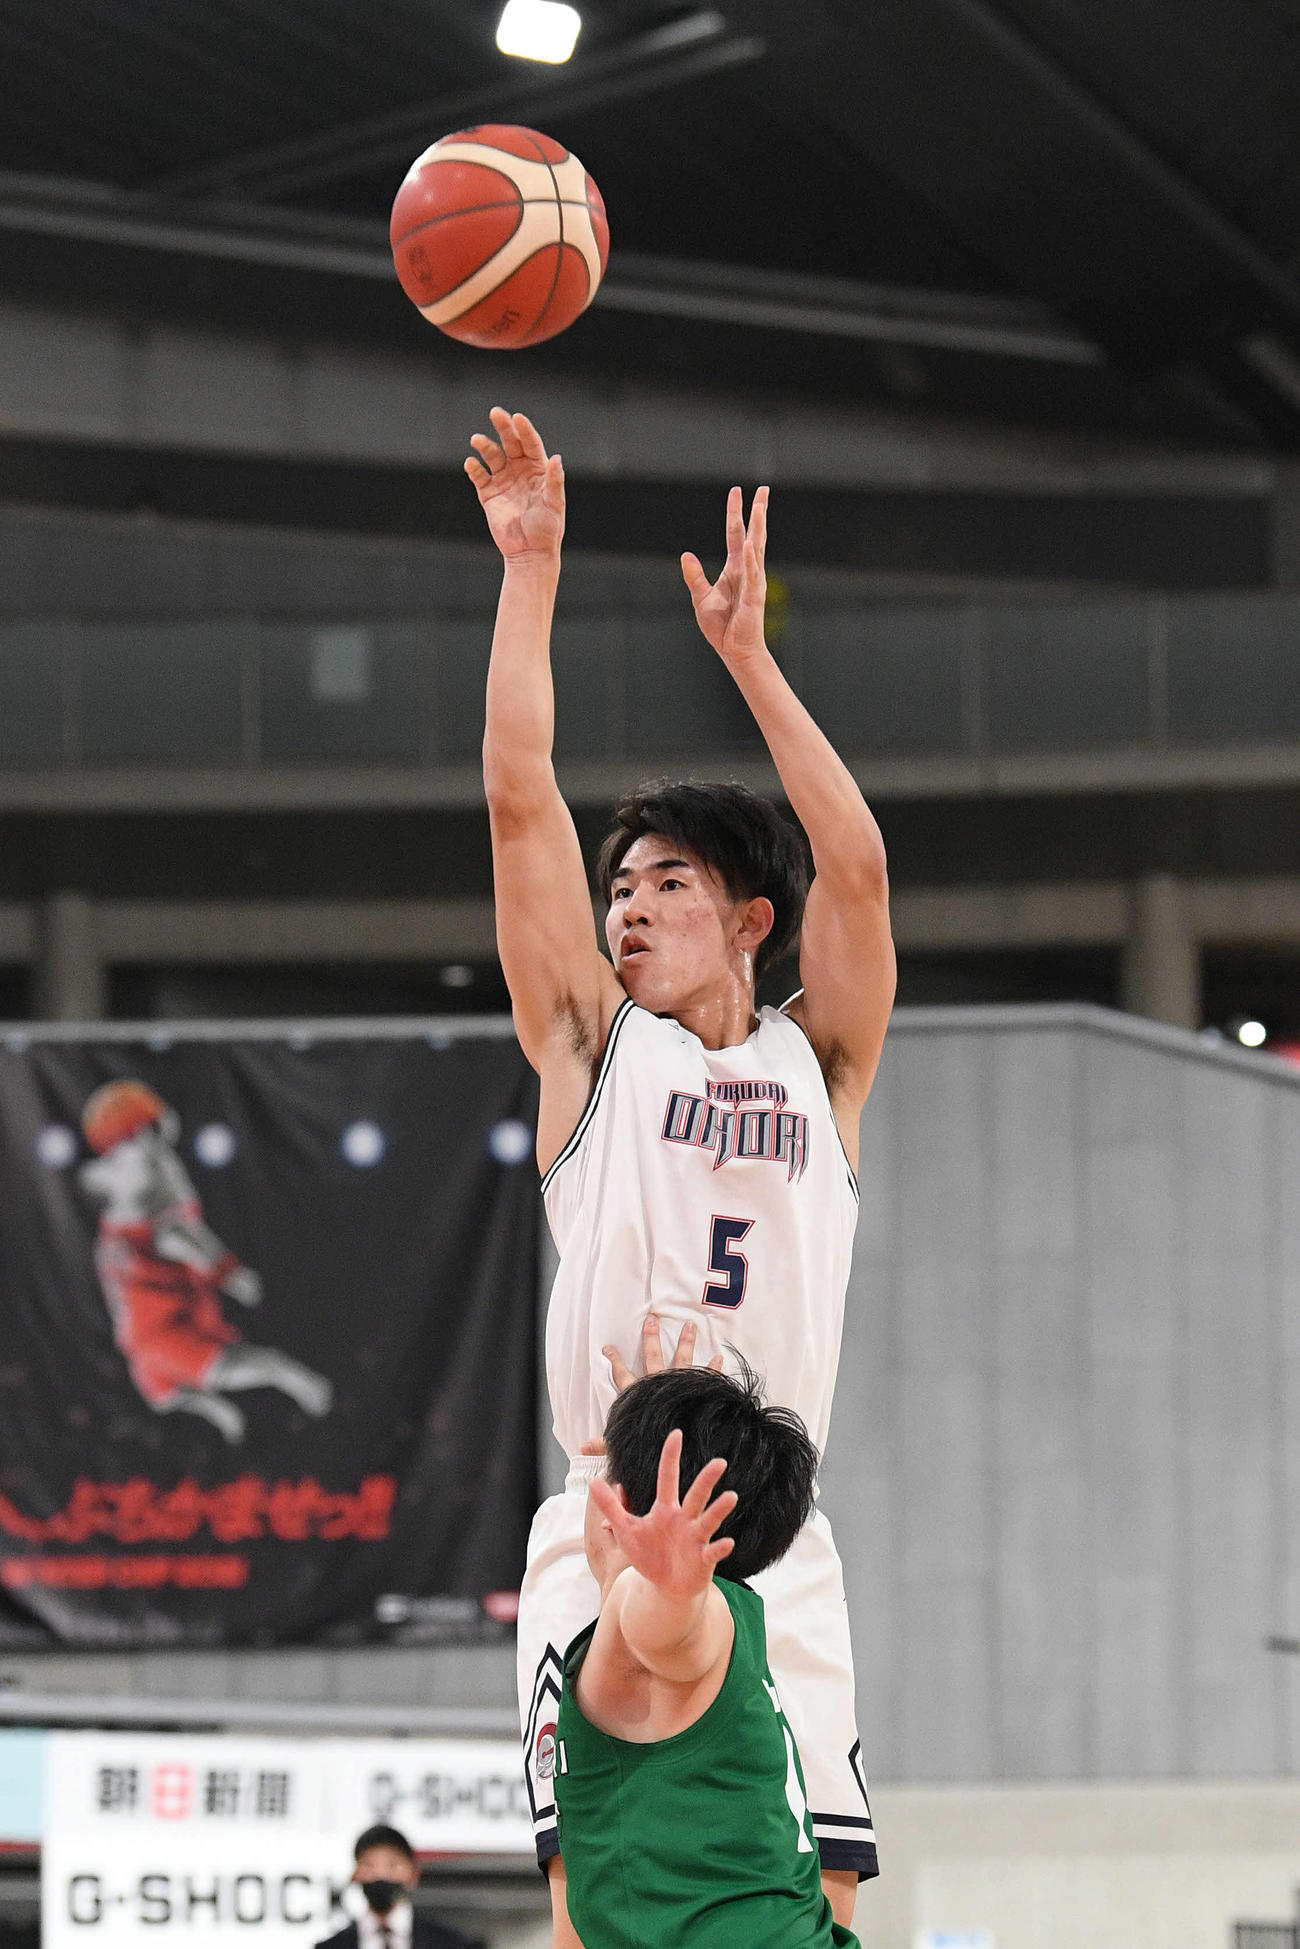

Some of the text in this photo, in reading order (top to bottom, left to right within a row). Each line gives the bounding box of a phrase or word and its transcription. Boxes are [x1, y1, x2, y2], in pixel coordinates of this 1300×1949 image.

[661, 1090, 809, 1184] OHORI
[705, 1078, 789, 1110] FUKUDAI
[701, 1214, 756, 1311] 5
